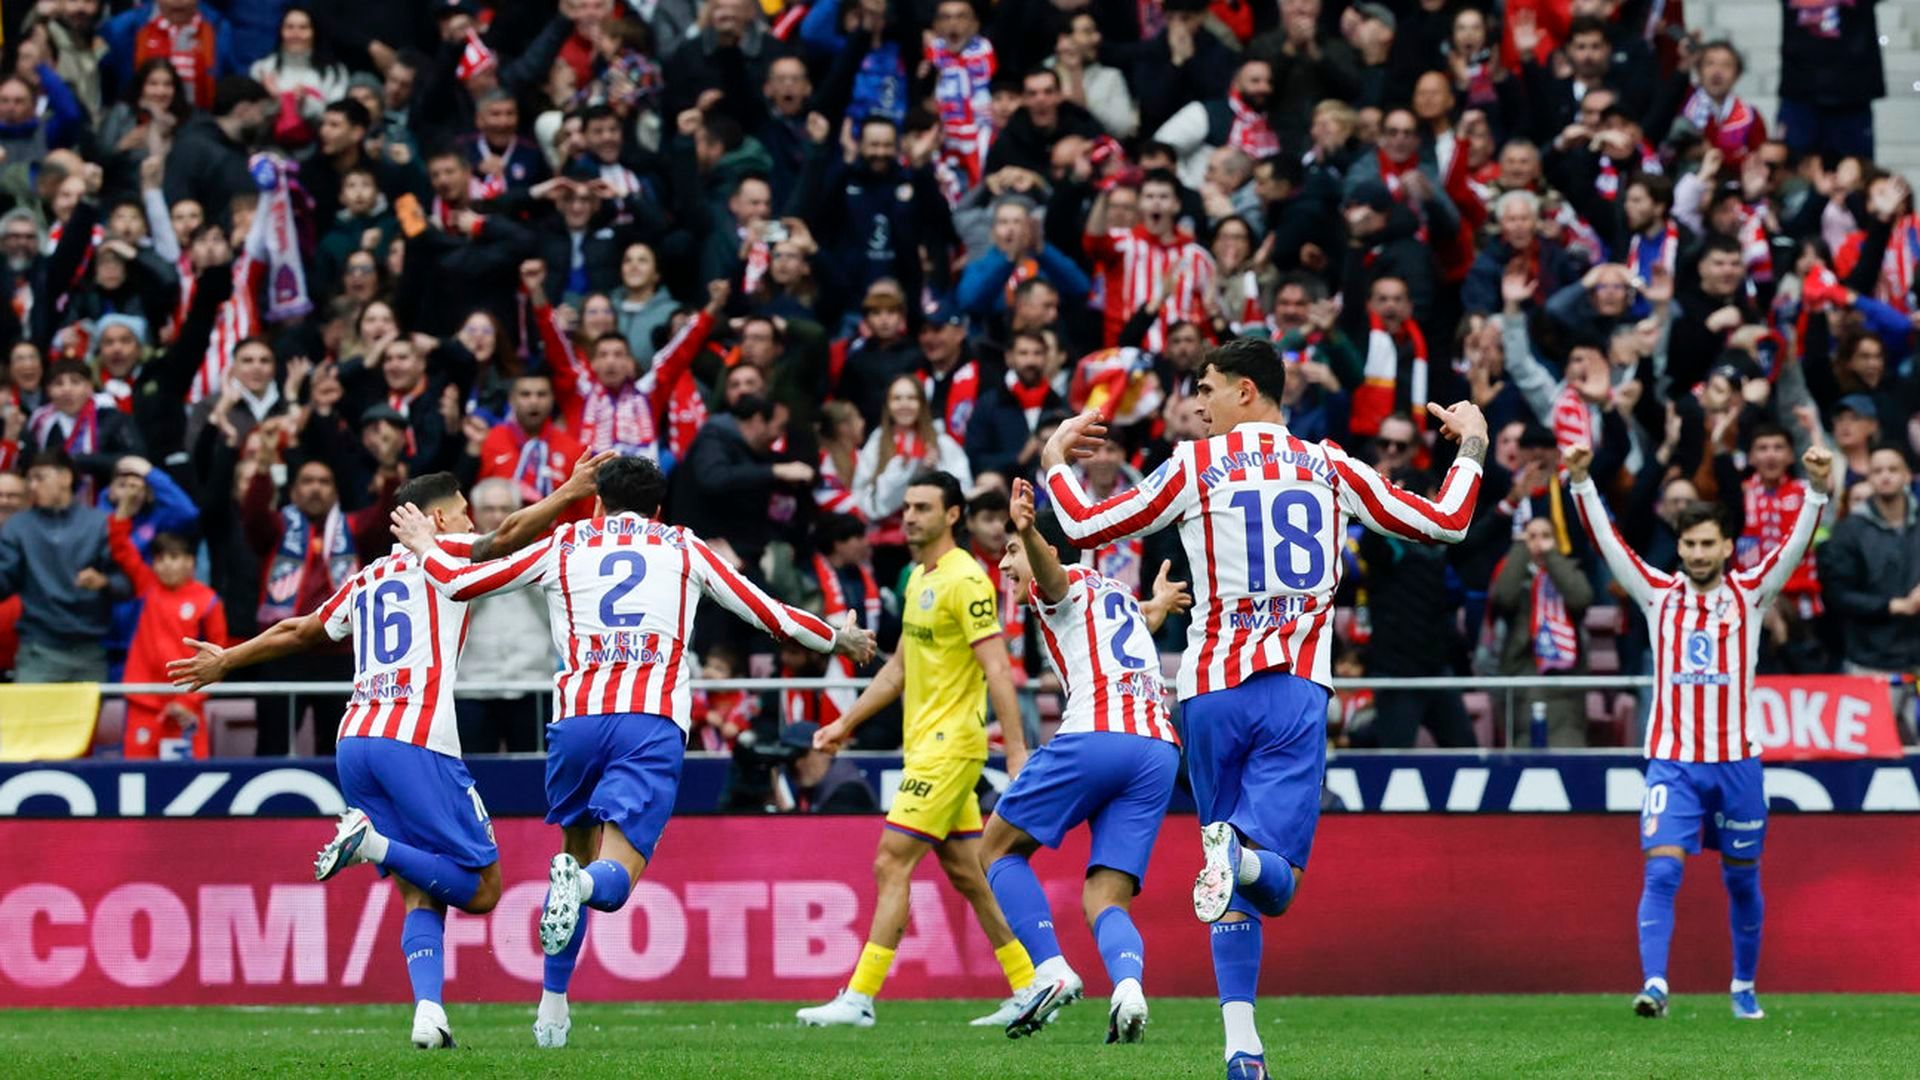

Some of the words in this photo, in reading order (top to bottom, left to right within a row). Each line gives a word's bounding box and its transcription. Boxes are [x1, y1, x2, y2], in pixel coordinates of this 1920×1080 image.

[1267, 450, 1336, 486] UBILL
[1229, 489, 1325, 593] 18
[600, 550, 647, 627] 2
[1253, 596, 1306, 612] VISIT
[354, 579, 412, 675] 16
[585, 648, 664, 663] RWANDA
[601, 631, 649, 646] VISIT
[1104, 592, 1146, 669] 2
[1752, 686, 1871, 755] OKE
